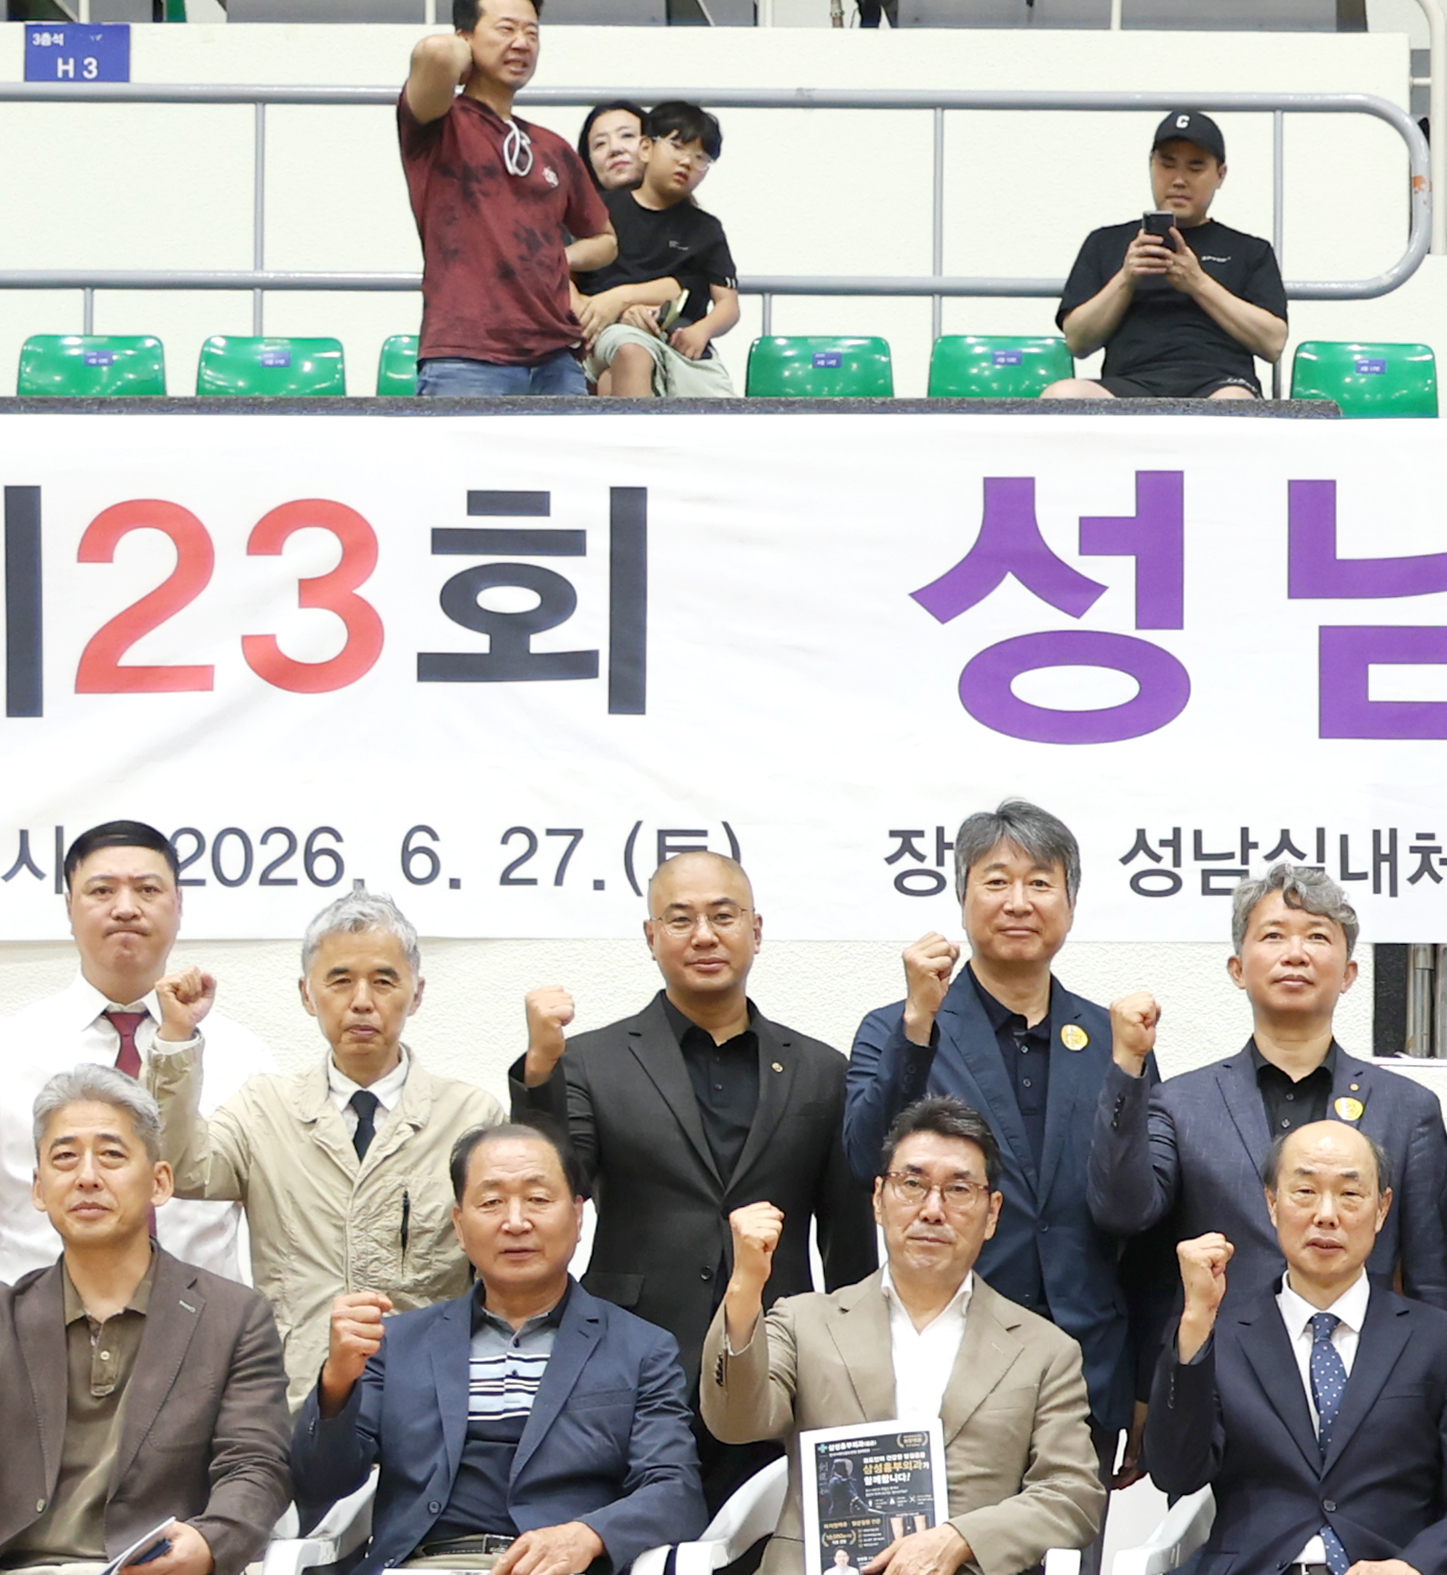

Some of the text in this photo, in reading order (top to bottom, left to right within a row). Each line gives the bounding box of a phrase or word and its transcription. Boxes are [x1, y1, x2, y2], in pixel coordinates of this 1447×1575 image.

[56, 56, 99, 79] H 3
[1175, 114, 1191, 129] C
[400, 824, 462, 890] 6.
[884, 826, 955, 897] 장
